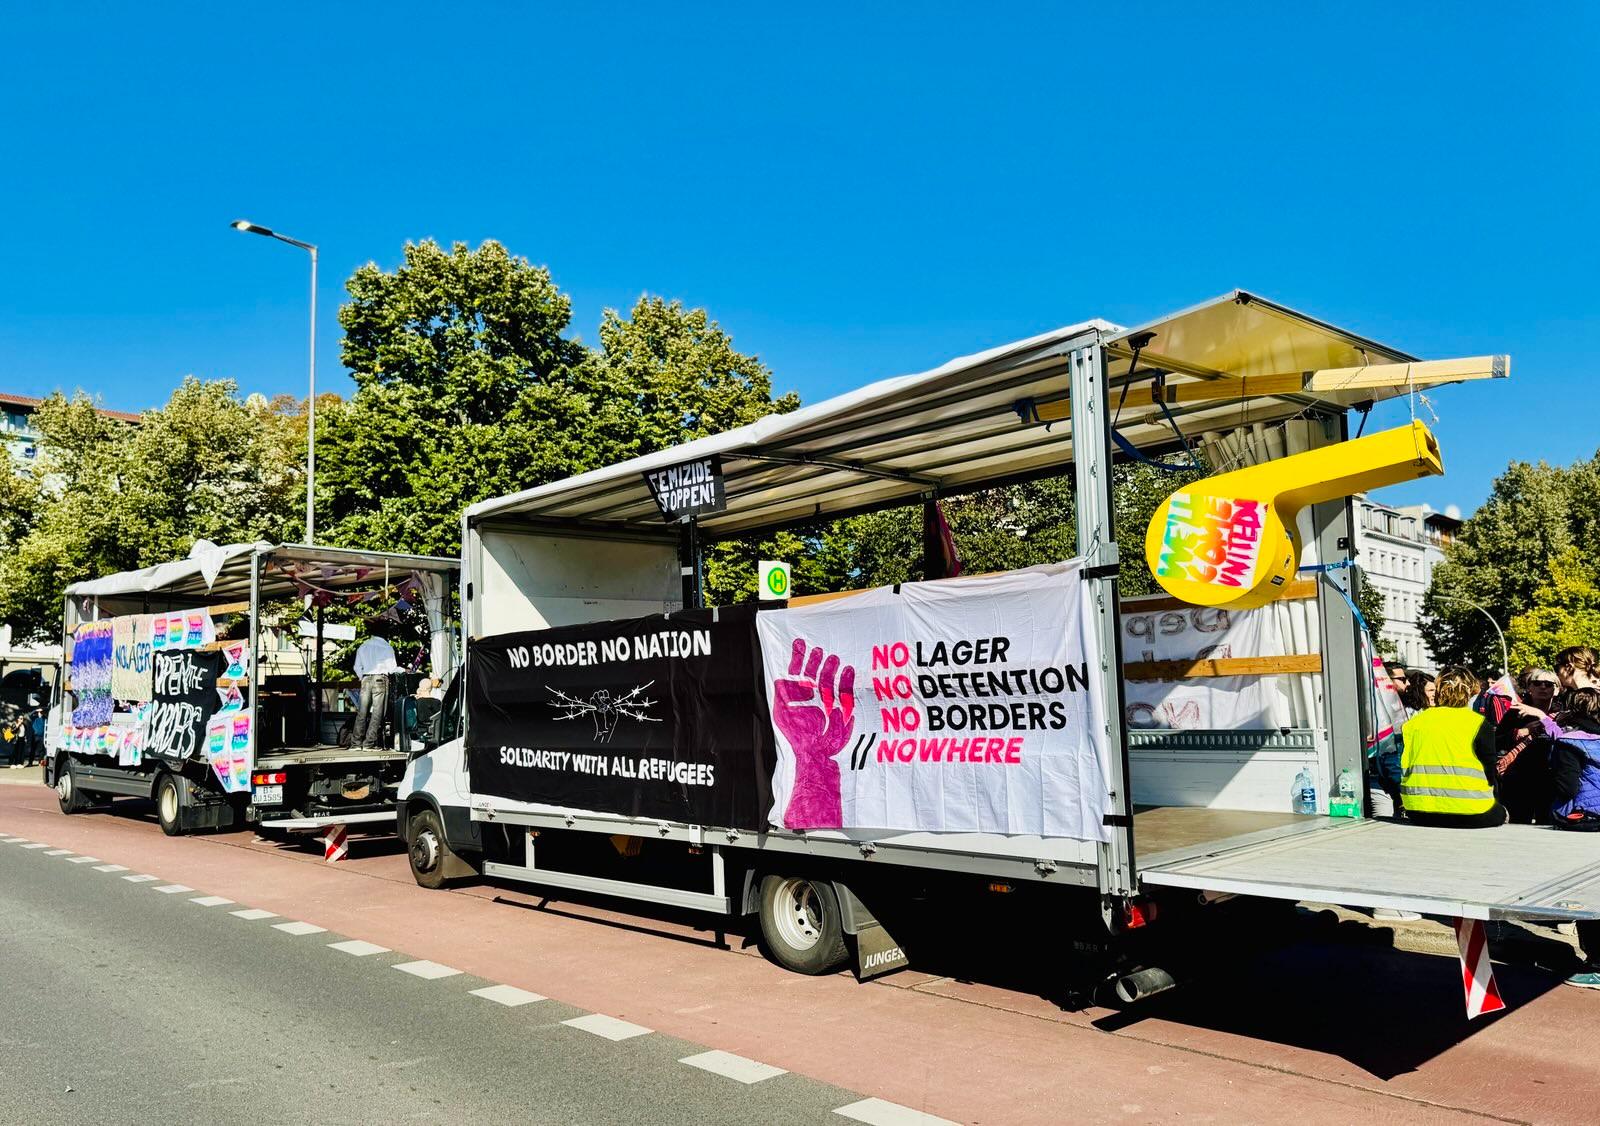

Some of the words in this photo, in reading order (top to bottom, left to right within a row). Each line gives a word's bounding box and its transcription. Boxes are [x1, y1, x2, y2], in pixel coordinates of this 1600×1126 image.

[506, 646, 530, 668] NO
[532, 641, 599, 666] BORDER
[601, 637, 631, 663] NO
[634, 630, 712, 660] NATION
[872, 642, 910, 671] NO
[916, 636, 1011, 668] LAGER
[155, 653, 192, 695] OPEN
[188, 664, 208, 690] THE
[872, 676, 913, 701] NO
[918, 662, 1090, 699] DETENTION
[881, 706, 921, 732] NO
[926, 701, 1067, 731] BORDERS
[500, 746, 571, 771] SOLIDARITY
[572, 754, 608, 776] WITH
[611, 756, 637, 778] ALL
[637, 758, 715, 786] REFUGEES
